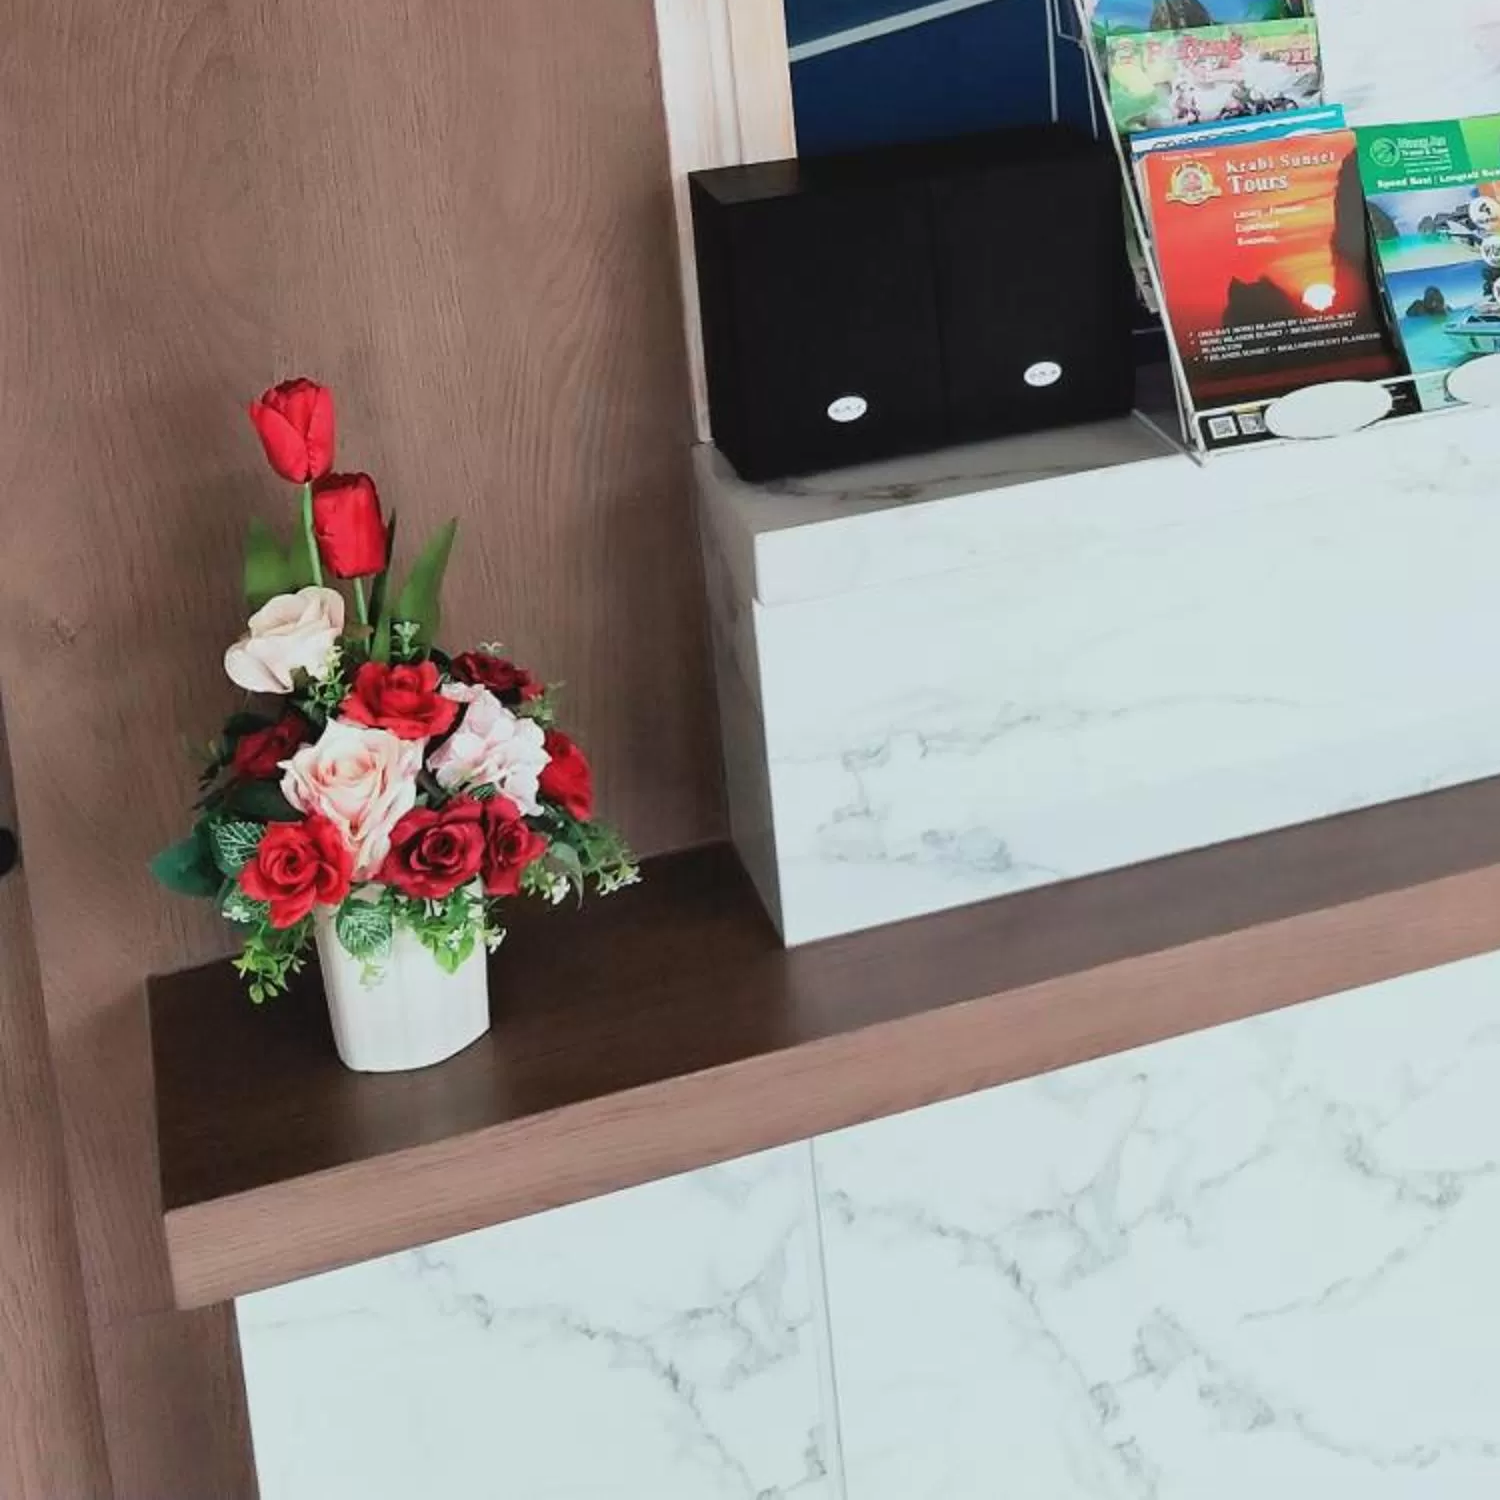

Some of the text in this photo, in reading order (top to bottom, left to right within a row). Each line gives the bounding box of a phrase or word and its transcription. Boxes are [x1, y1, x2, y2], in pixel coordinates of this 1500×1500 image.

[1225, 156, 1275, 174] Krabi
[1280, 151, 1336, 168] Sunset
[1227, 174, 1289, 195] Tours
[1377, 177, 1408, 190] Speed
